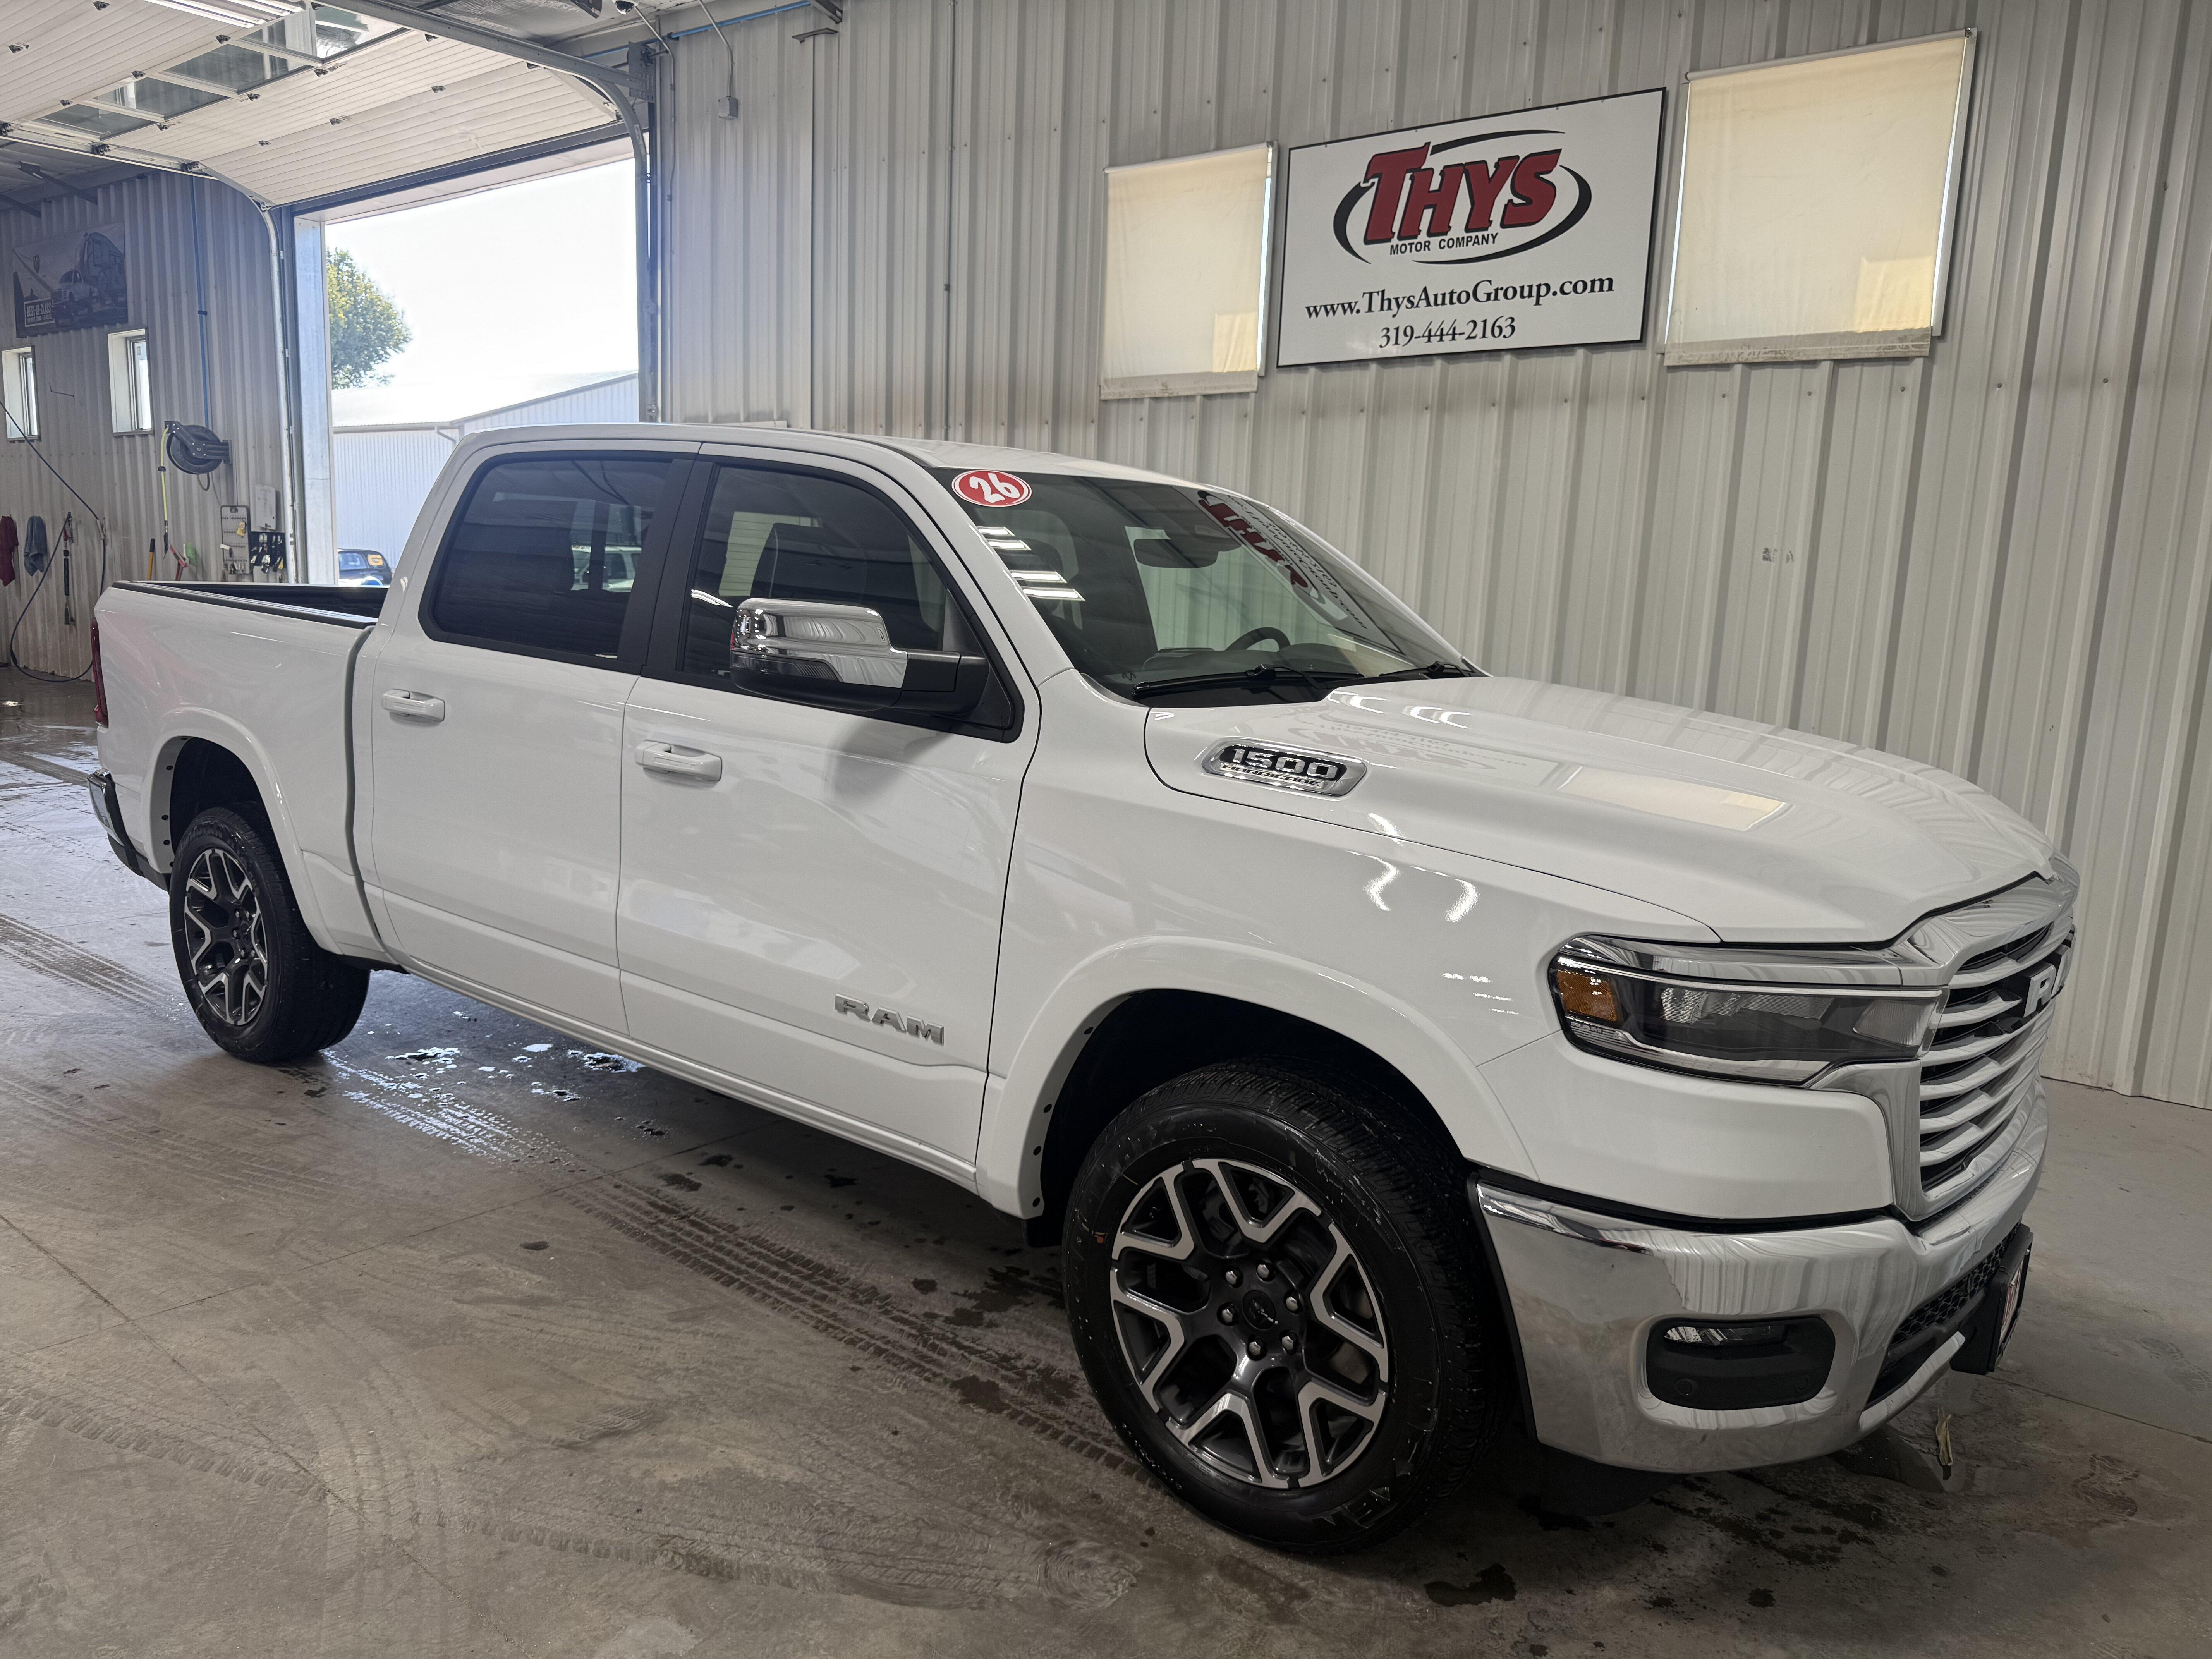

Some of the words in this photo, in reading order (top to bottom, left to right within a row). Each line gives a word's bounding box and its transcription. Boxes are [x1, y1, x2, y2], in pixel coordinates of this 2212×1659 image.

[1360, 142, 1562, 245] THYS
[1389, 240, 1431, 256] MOTOR
[1438, 233, 1498, 251] COMPANY
[1305, 276, 1614, 319] www.ThysAutoGroup.com
[1379, 316, 1516, 349] 319-444-2163
[969, 473, 1020, 503] 26
[1233, 749, 1338, 778] 1500
[835, 993, 944, 1046] RAM
[1571, 1021, 1603, 1034] RAM
